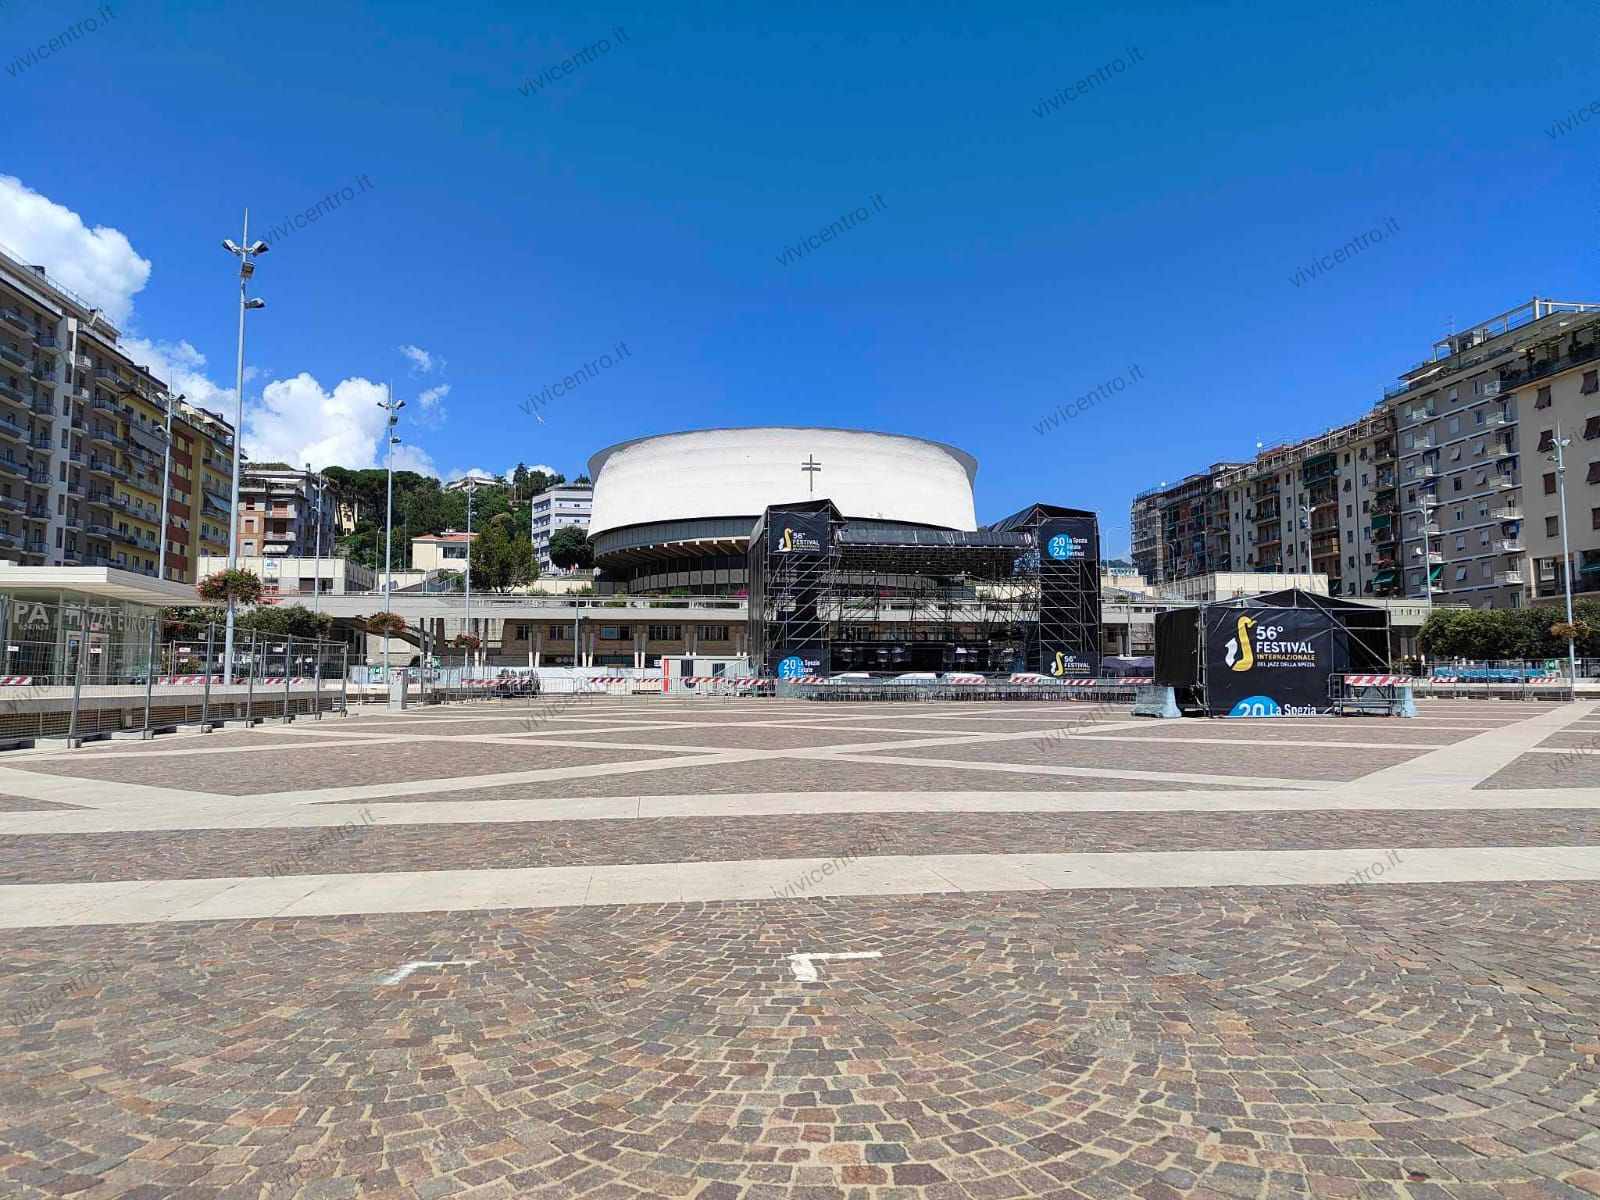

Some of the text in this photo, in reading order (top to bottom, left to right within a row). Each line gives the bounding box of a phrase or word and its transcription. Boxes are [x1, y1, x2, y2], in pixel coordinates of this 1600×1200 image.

[1053, 537, 1065, 546] 20
[1053, 547, 1066, 556] 24
[1256, 626, 1284, 640] 56°
[1256, 641, 1315, 653] FESTIVAL
[784, 660, 796, 669] 20
[1240, 703, 1265, 717] 20
[1284, 704, 1316, 717] Spezia
